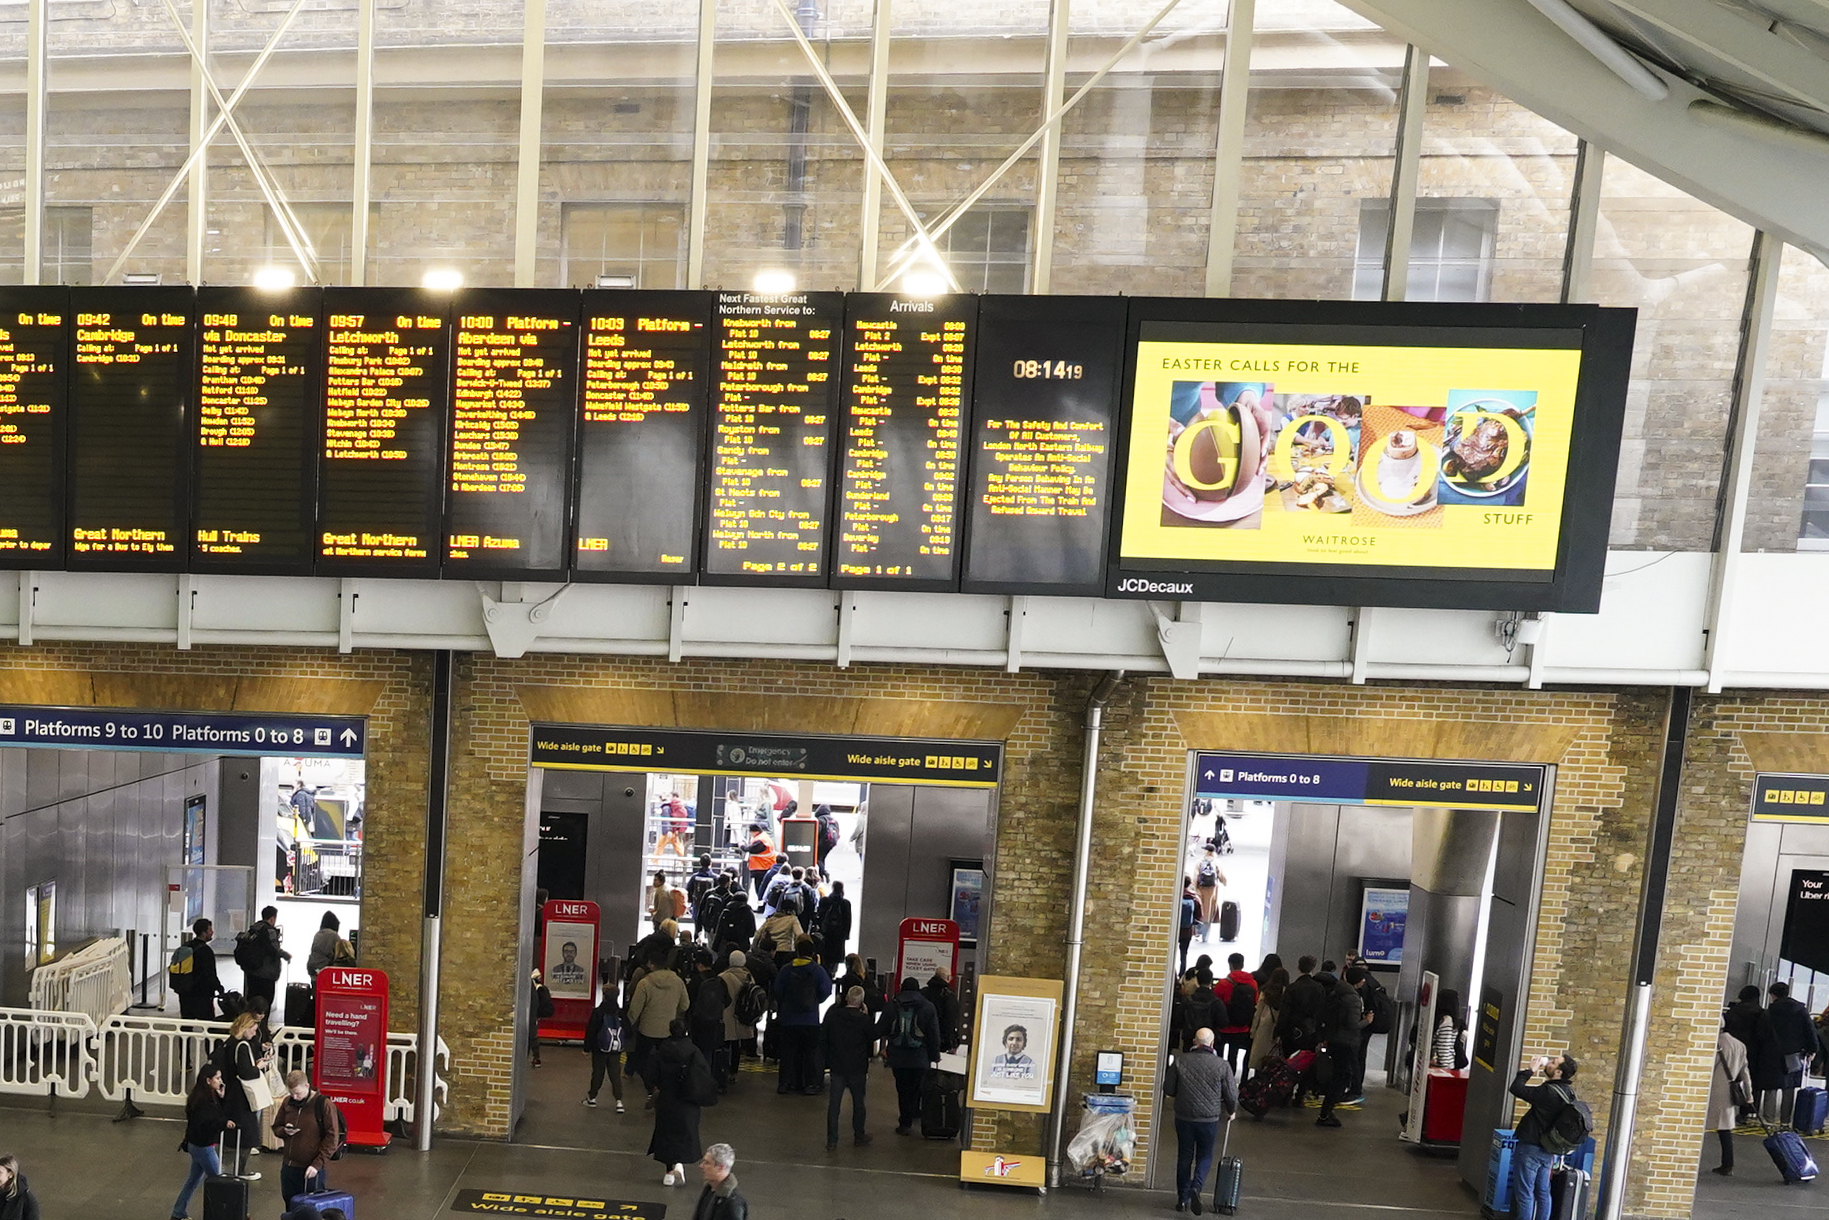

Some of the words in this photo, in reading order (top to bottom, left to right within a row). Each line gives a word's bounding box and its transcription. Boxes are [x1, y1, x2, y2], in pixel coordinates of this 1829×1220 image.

[720, 294, 741, 303] Next
[744, 294, 778, 303] Fastest
[781, 295, 807, 304] Great
[719, 306, 762, 314] Northern
[765, 306, 801, 315] Service
[803, 307, 815, 315] to:
[891, 301, 934, 312] Arrivals
[77, 314, 110, 325] 09:42
[204, 315, 237, 326] 09:48
[330, 316, 364, 327] 09:57
[461, 317, 493, 328] 10:00
[591, 318, 624, 330] 10:03
[77, 330, 135, 342] Cambridge
[204, 331, 220, 342] via
[226, 331, 286, 342] Doncaster
[330, 332, 398, 343] Letchworth
[458, 334, 514, 344] Aberdeen
[520, 335, 537, 345] via
[589, 335, 624, 346] Leeds
[1163, 358, 1222, 370] EASTER
[1231, 360, 1280, 372] CALLS
[1288, 361, 1319, 372] FOR
[1328, 362, 1359, 373] THE
[1483, 513, 1533, 525] STUFF
[198, 531, 218, 542] Hull
[223, 531, 260, 543] Trains
[1303, 535, 1376, 546] WAITROSE
[1118, 579, 1193, 594] JCDecaux
[25, 720, 101, 738] Platforms
[105, 723, 116, 737] 9
[120, 725, 137, 739] to
[143, 724, 163, 740] 10
[172, 725, 250, 742] Platforms
[255, 727, 264, 742] 0
[270, 729, 288, 744] to
[293, 729, 303, 744] 8
[537, 741, 558, 750] Wide
[561, 742, 580, 751] aisle
[582, 744, 602, 753] gate
[848, 754, 872, 765] Wide
[874, 756, 896, 766] aisle
[898, 758, 920, 768] gate
[1238, 772, 1287, 785] Platforms
[1290, 774, 1297, 783] 0
[1299, 774, 1310, 784] to
[1313, 775, 1320, 785] 8
[1390, 778, 1414, 788] Wide
[1416, 778, 1438, 789] aisle
[1440, 781, 1461, 790] gate
[1802, 880, 1823, 889] Your
[1800, 891, 1823, 900] Uber
[555, 903, 588, 915] LNER
[912, 922, 947, 935] LNER
[332, 971, 372, 986] LNER
[350, 1012, 367, 1020] hand
[470, 1202, 528, 1213] Wide
[534, 1209, 586, 1218] aisle
